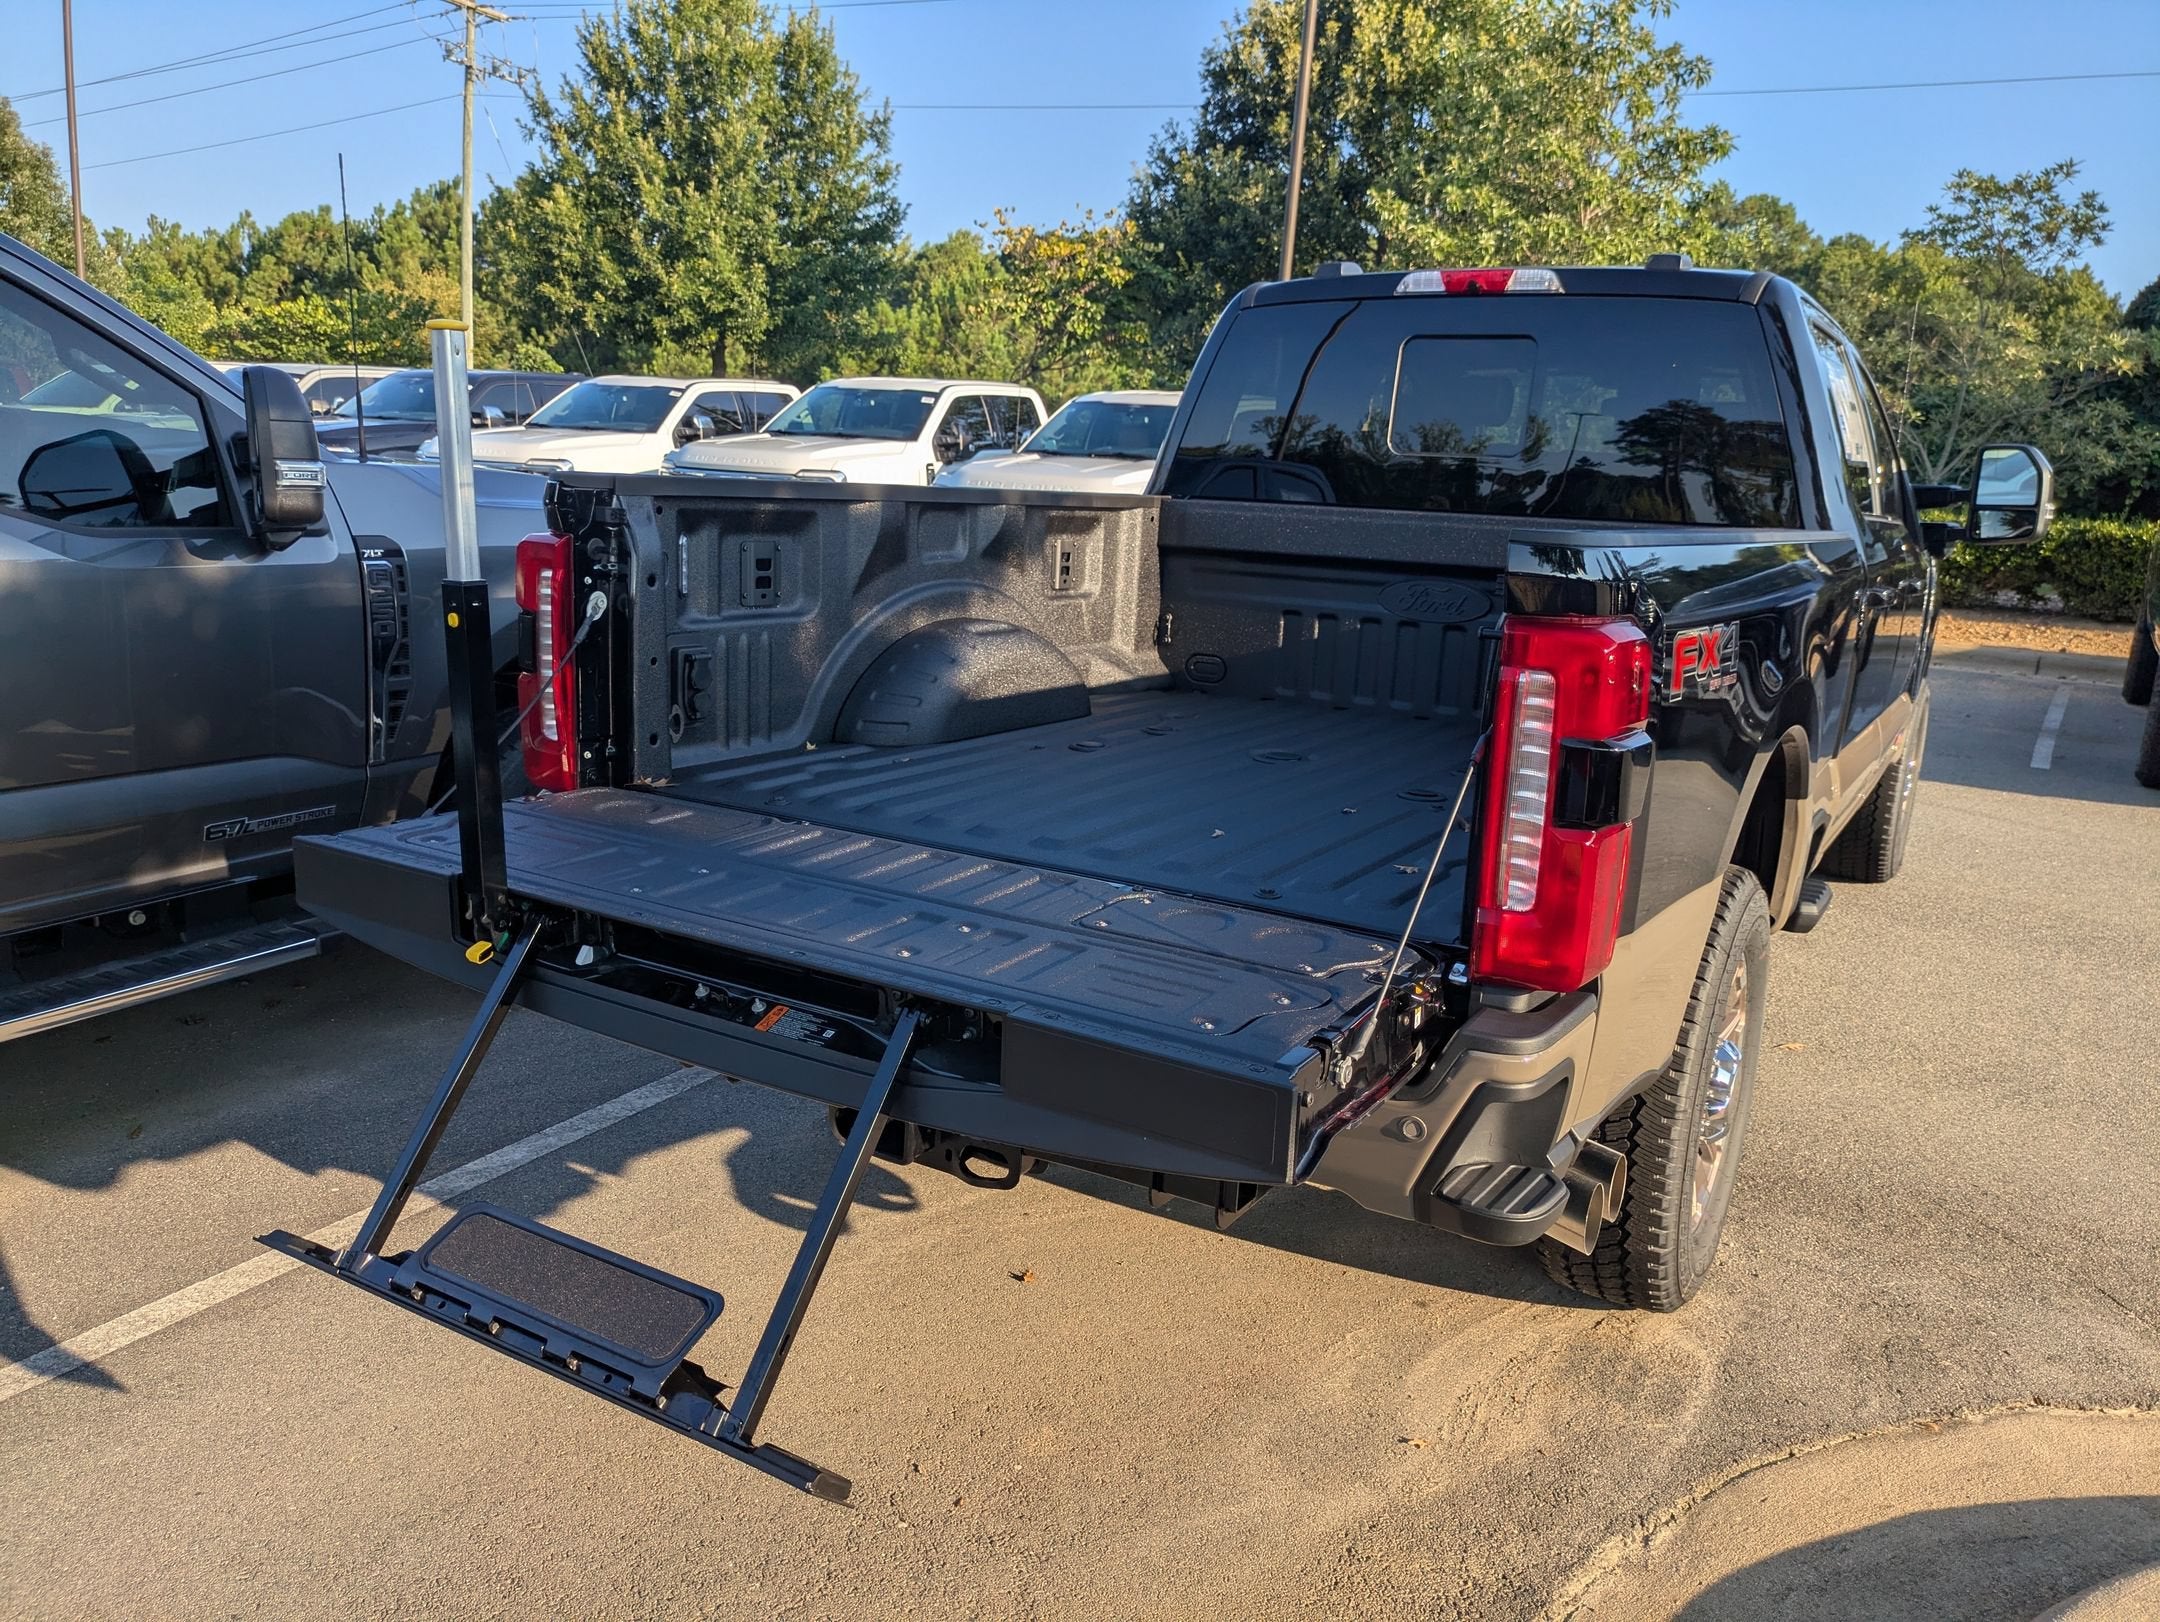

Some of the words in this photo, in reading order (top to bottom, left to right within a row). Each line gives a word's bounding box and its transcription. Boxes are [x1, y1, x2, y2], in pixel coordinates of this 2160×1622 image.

[361, 549, 385, 558] XLT
[1399, 583, 1467, 616] Ford
[1669, 620, 1741, 703] FX4
[257, 815, 294, 831] POWER
[295, 806, 336, 823] STROKE
